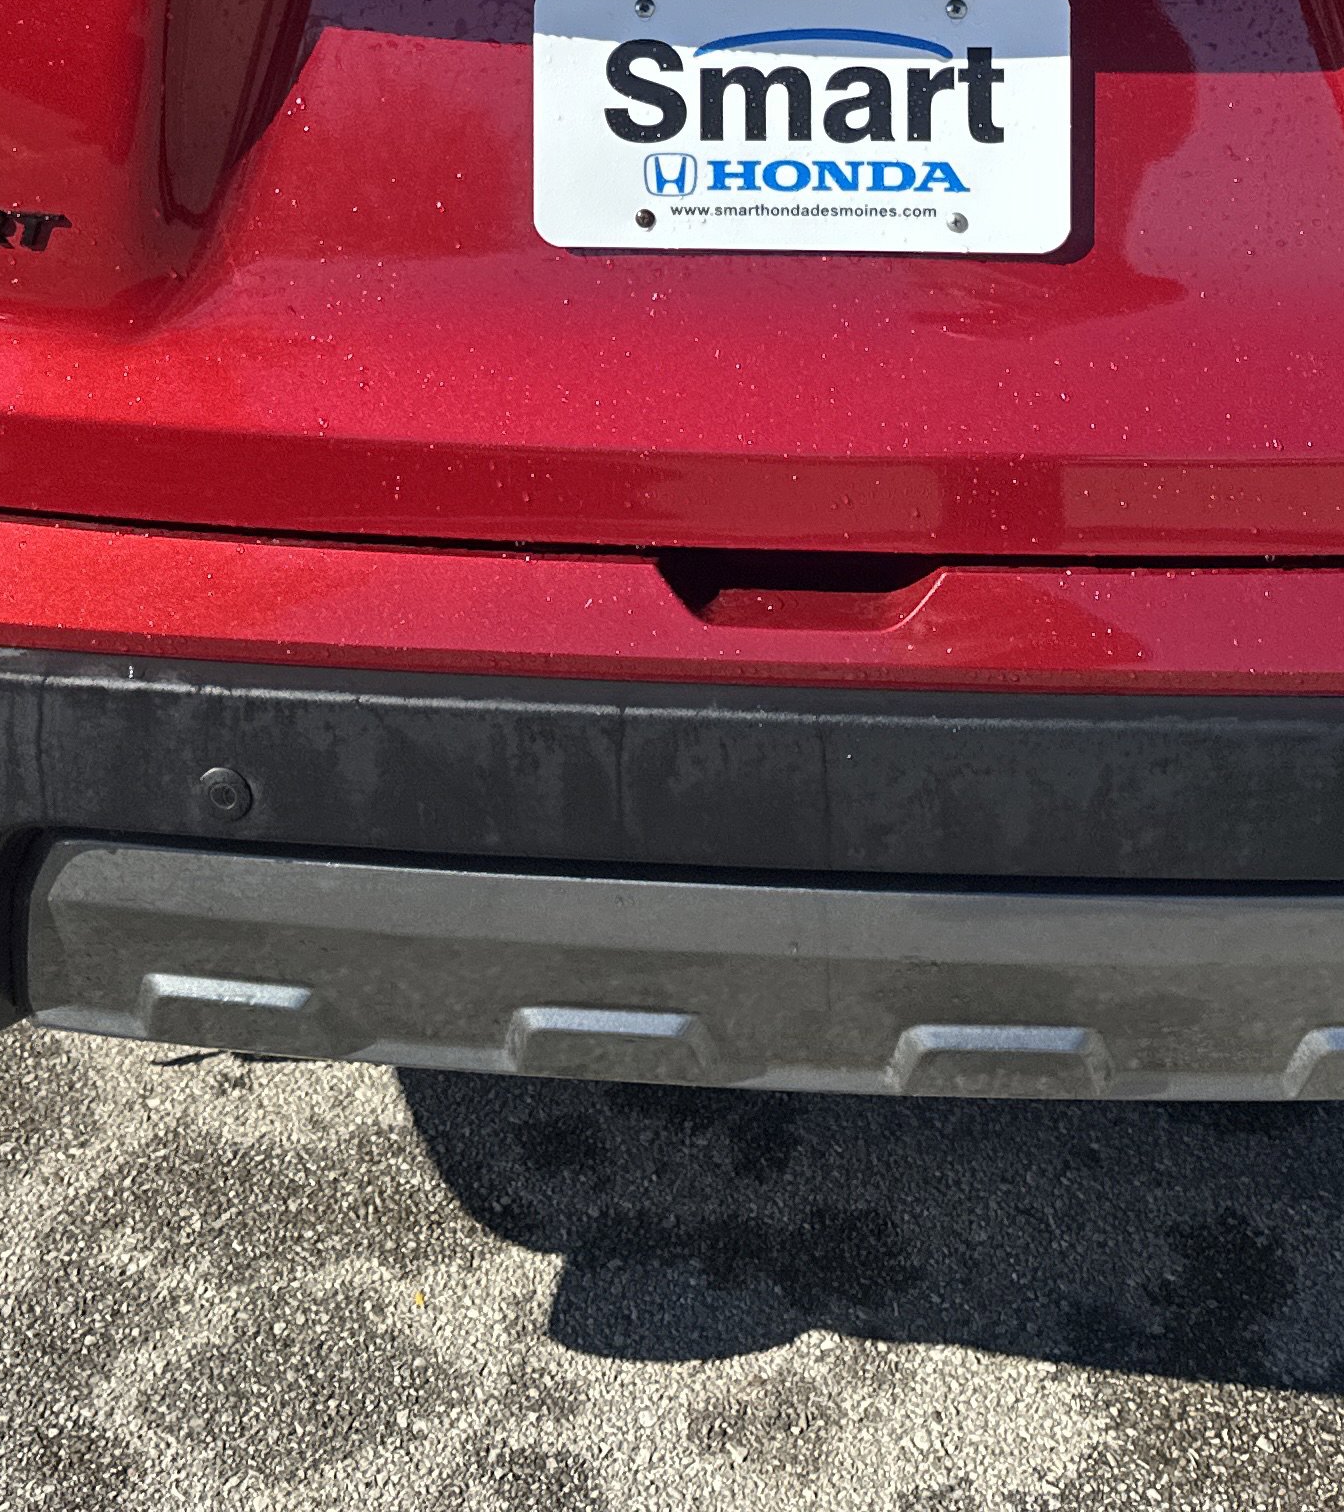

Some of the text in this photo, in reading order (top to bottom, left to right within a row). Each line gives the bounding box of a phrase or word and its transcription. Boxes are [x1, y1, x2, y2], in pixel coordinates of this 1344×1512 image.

[604, 39, 1005, 144] Smart
[706, 160, 971, 193] HONDA
[670, 204, 937, 219] www.smarthondadesmoines.com
